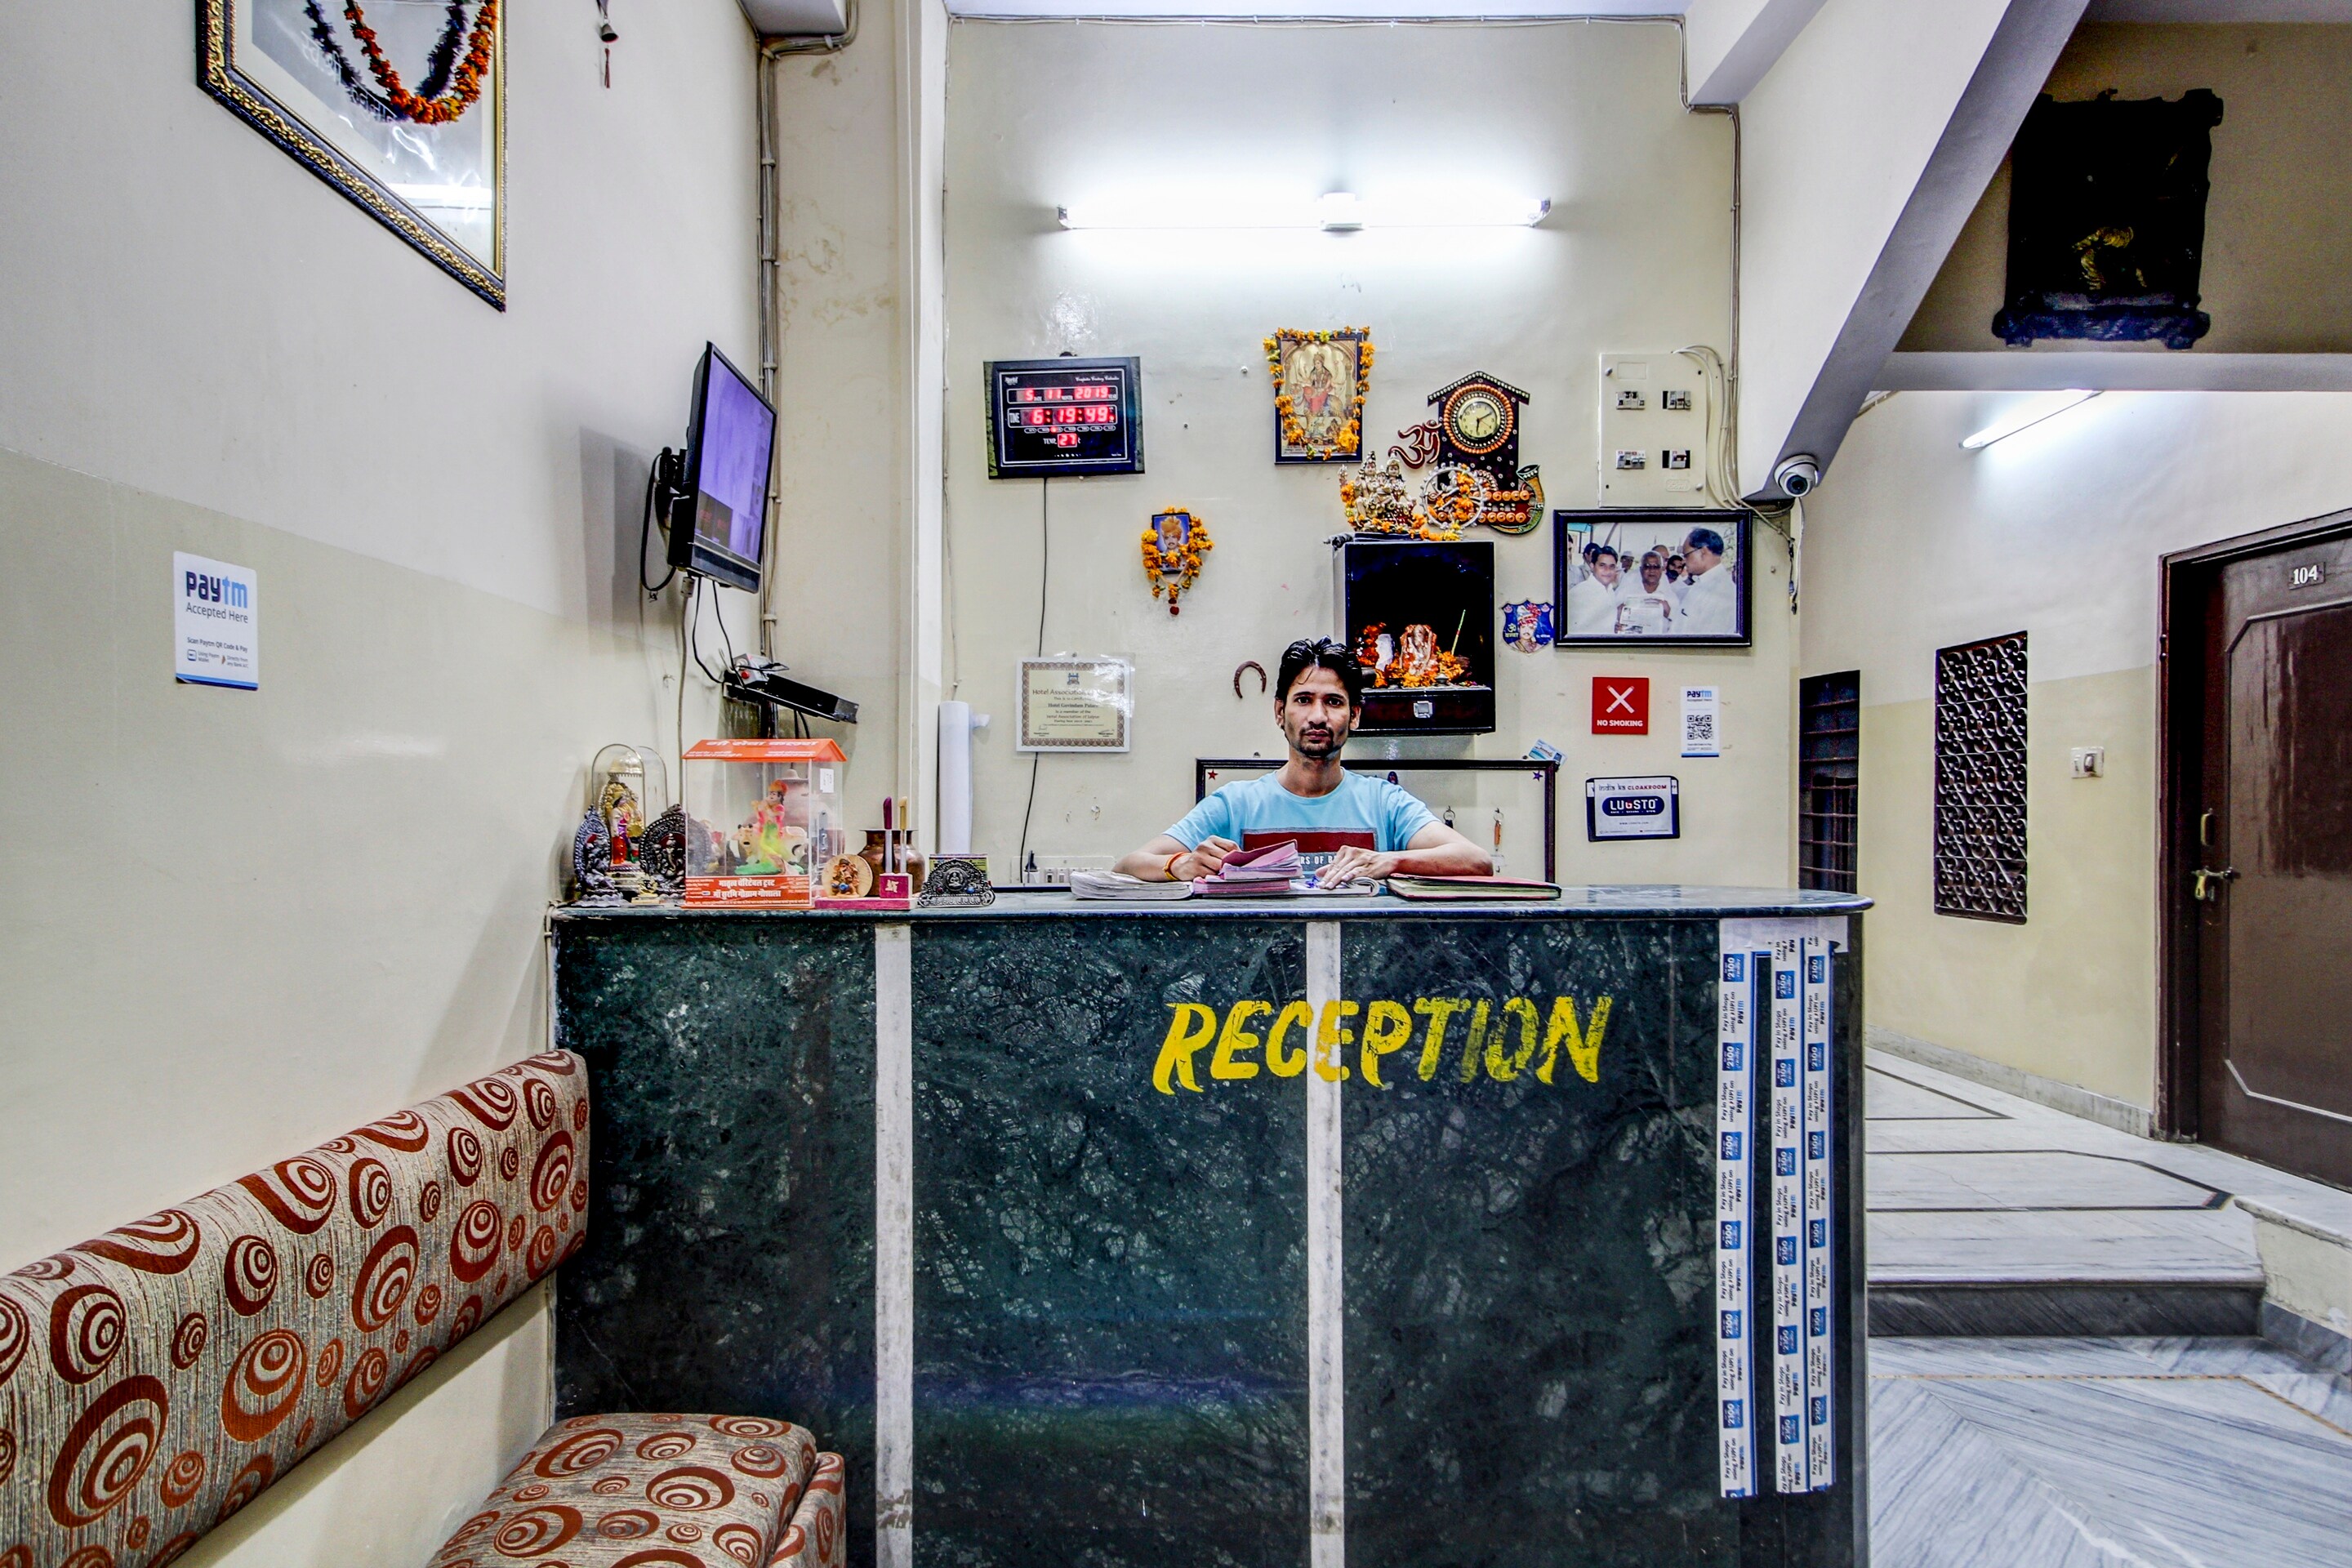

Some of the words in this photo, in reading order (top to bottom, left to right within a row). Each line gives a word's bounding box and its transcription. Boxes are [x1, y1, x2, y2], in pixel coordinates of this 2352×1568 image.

[1074, 385, 1109, 399] 2019
[1058, 434, 1076, 446] 27
[2293, 565, 2318, 585] 104
[186, 602, 226, 619] Accepted
[229, 610, 248, 624] Here
[1300, 856, 1311, 865] RS
[1314, 856, 1324, 864] OF
[1152, 996, 1613, 1096] RECEPTION
